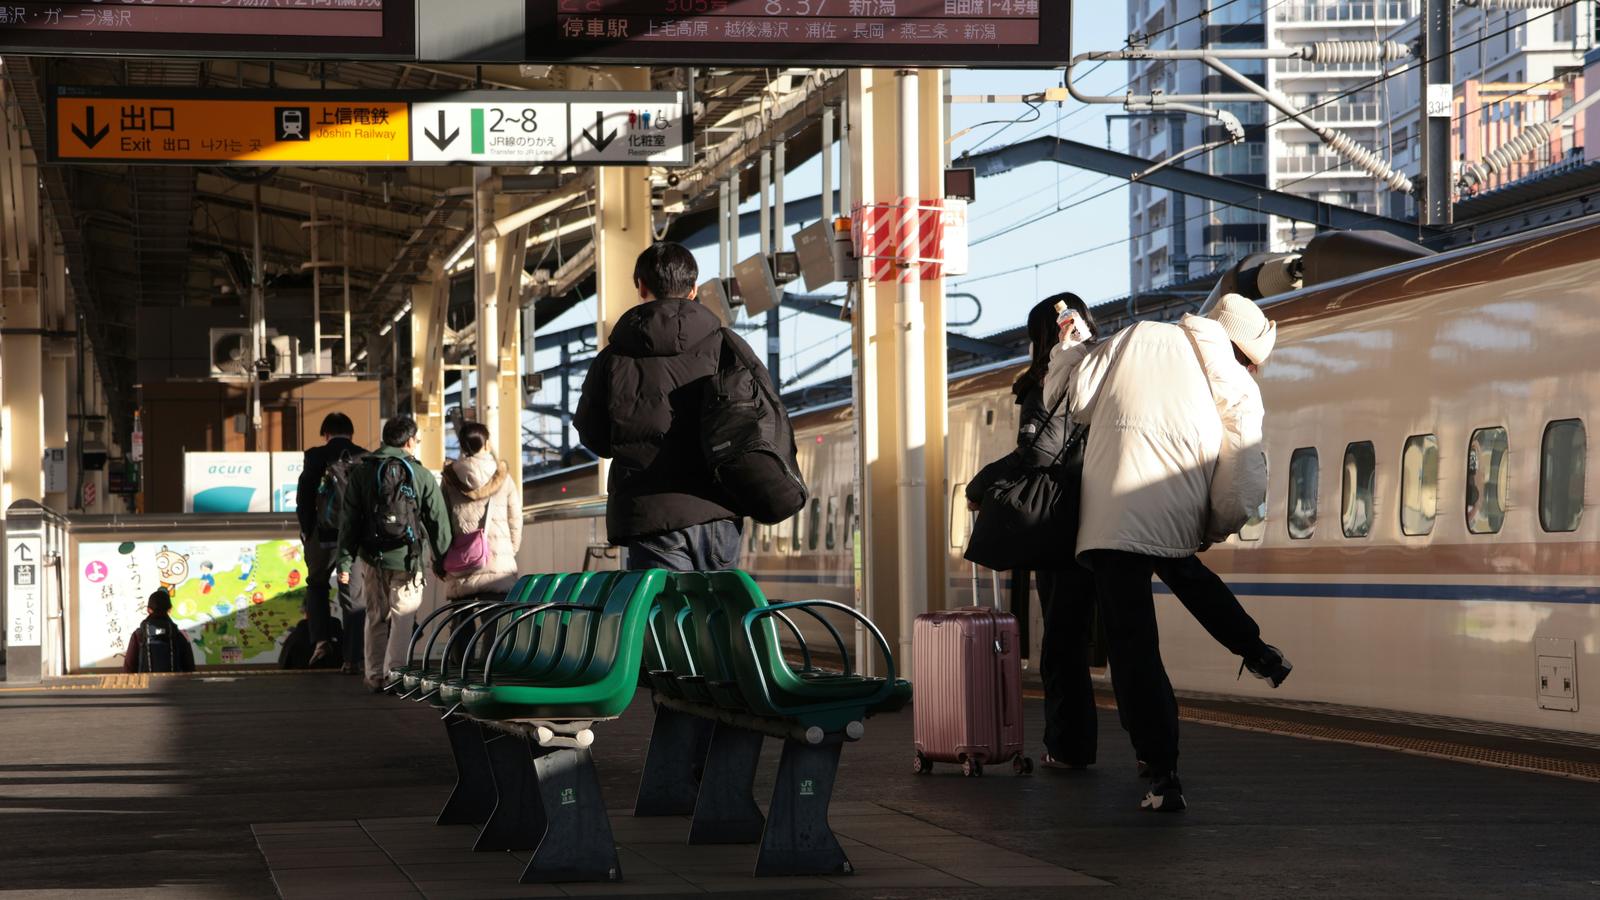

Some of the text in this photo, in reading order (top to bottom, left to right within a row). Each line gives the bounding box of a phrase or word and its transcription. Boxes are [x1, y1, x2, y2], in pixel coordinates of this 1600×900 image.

[562, 17, 629, 38] 停車駅
[120, 104, 175, 132] 出口
[316, 107, 389, 125] 上信電鉄
[354, 127, 397, 141] Railway
[628, 134, 666, 147] 化粧室
[121, 136, 152, 152] Exit
[163, 138, 190, 151] 出口
[489, 136, 557, 148] JR線のりかえ
[208, 464, 253, 475] acure
[14, 617, 23, 642] この先
[801, 779, 813, 787] JR
[561, 788, 573, 797] JR
